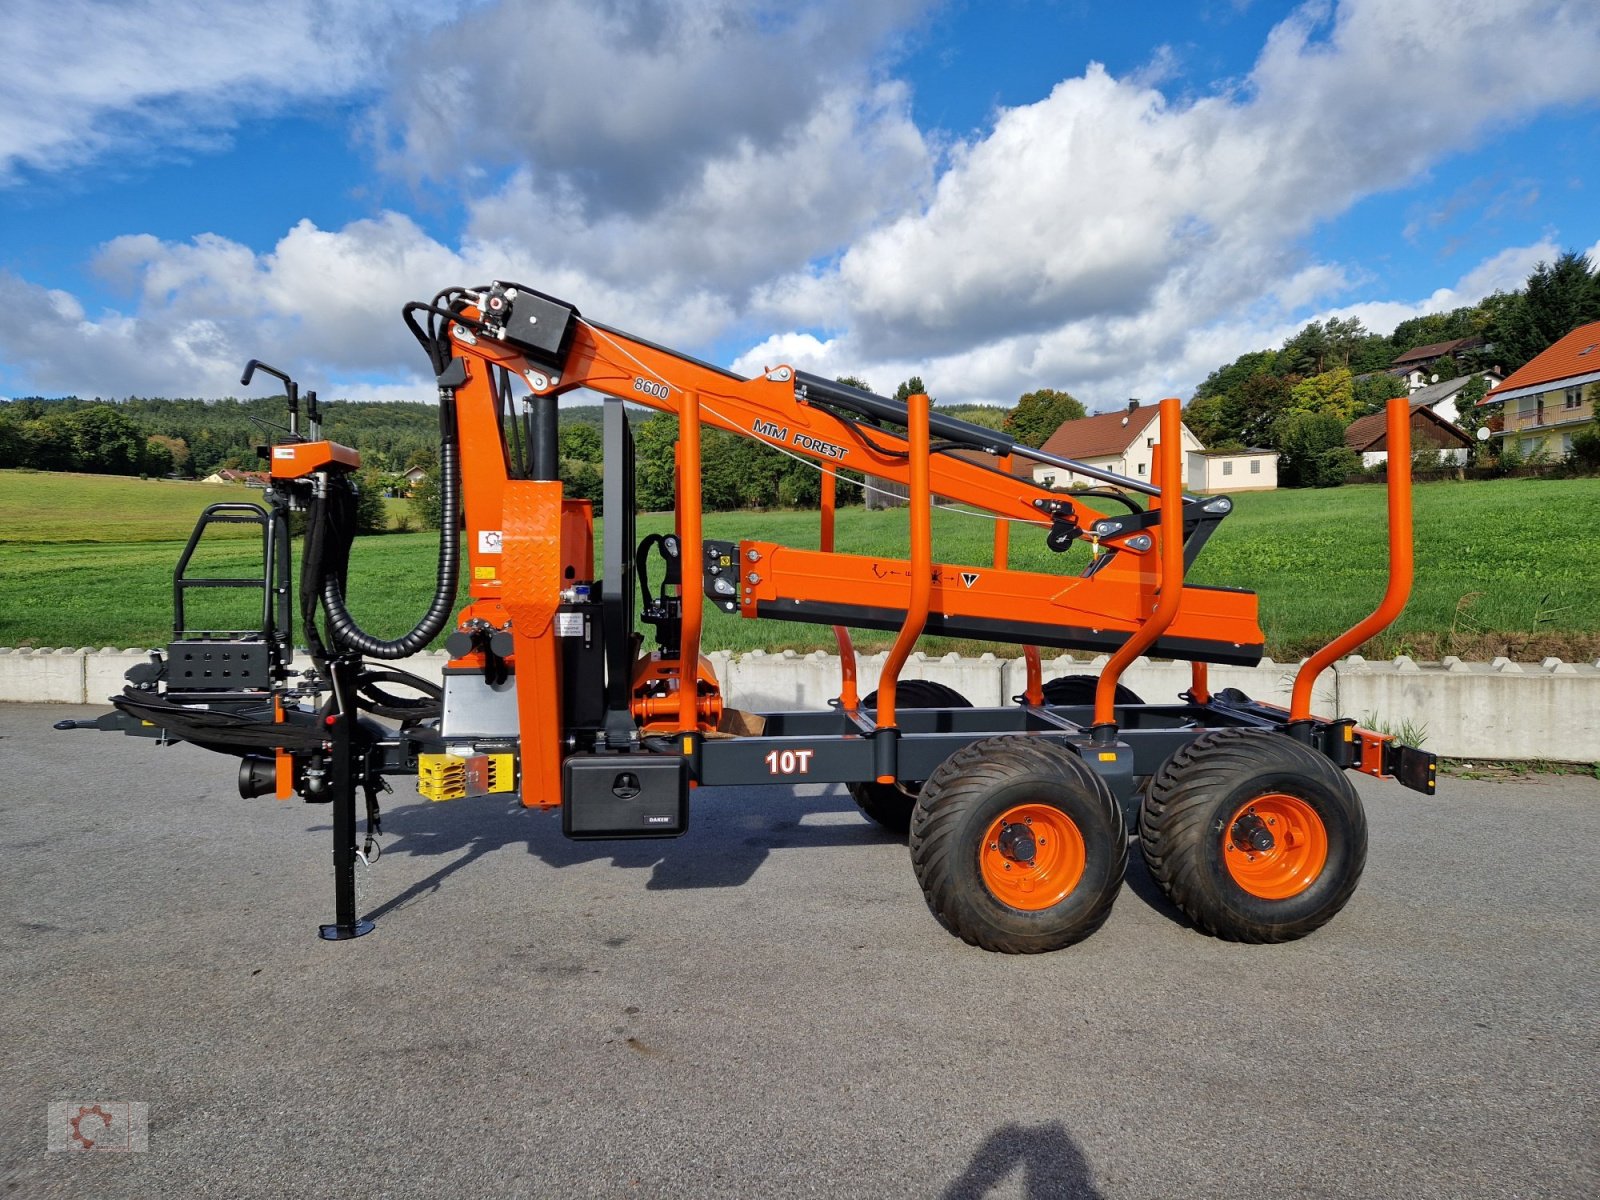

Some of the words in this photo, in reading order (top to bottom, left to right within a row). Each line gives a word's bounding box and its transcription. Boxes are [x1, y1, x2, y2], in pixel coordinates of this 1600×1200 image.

[634, 377, 669, 399] 8600
[753, 418, 788, 441] MTM
[793, 433, 848, 460] FOREST
[765, 749, 813, 774] 10T
